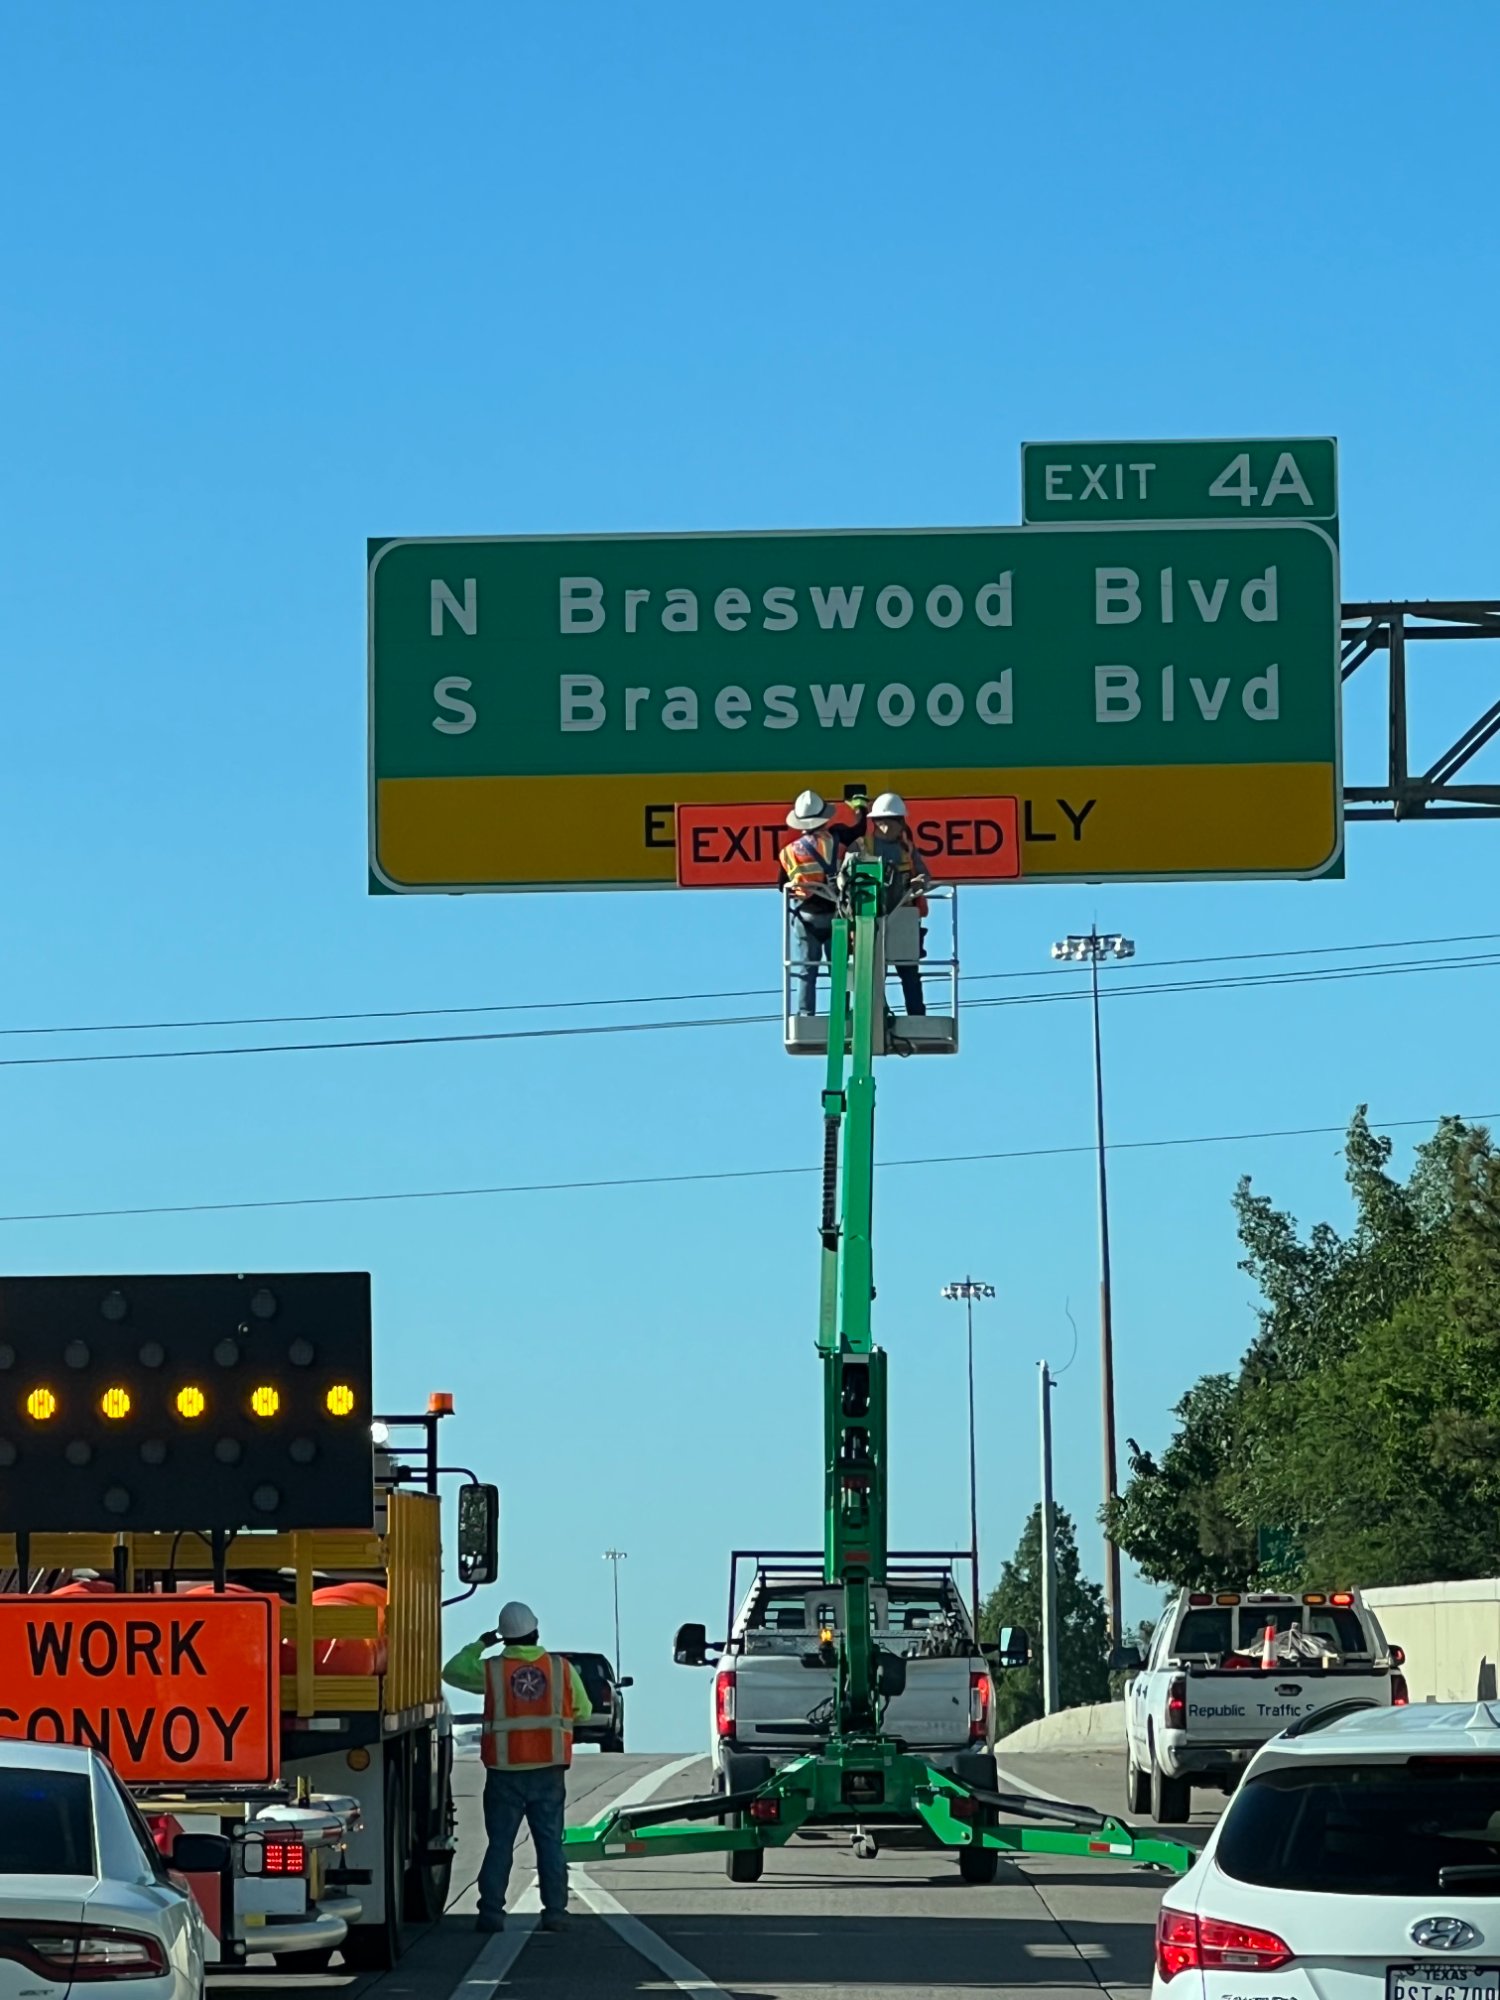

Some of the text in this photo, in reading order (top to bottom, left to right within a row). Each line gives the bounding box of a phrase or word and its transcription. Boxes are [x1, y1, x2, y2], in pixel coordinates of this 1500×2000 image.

[1045, 452, 1314, 507] EXIT 4A
[430, 565, 1278, 636] N Braeswood Blvd
[431, 663, 1279, 734] S Braeswood Blvd
[692, 825, 788, 863] EXIT
[906, 820, 1003, 857] SED
[1024, 799, 1096, 841] LY
[26, 1620, 207, 1677] WORK
[1189, 1704, 1246, 1718] Republic
[1256, 1704, 1301, 1717] Traffic
[1425, 1970, 1467, 1980] TEXAS
